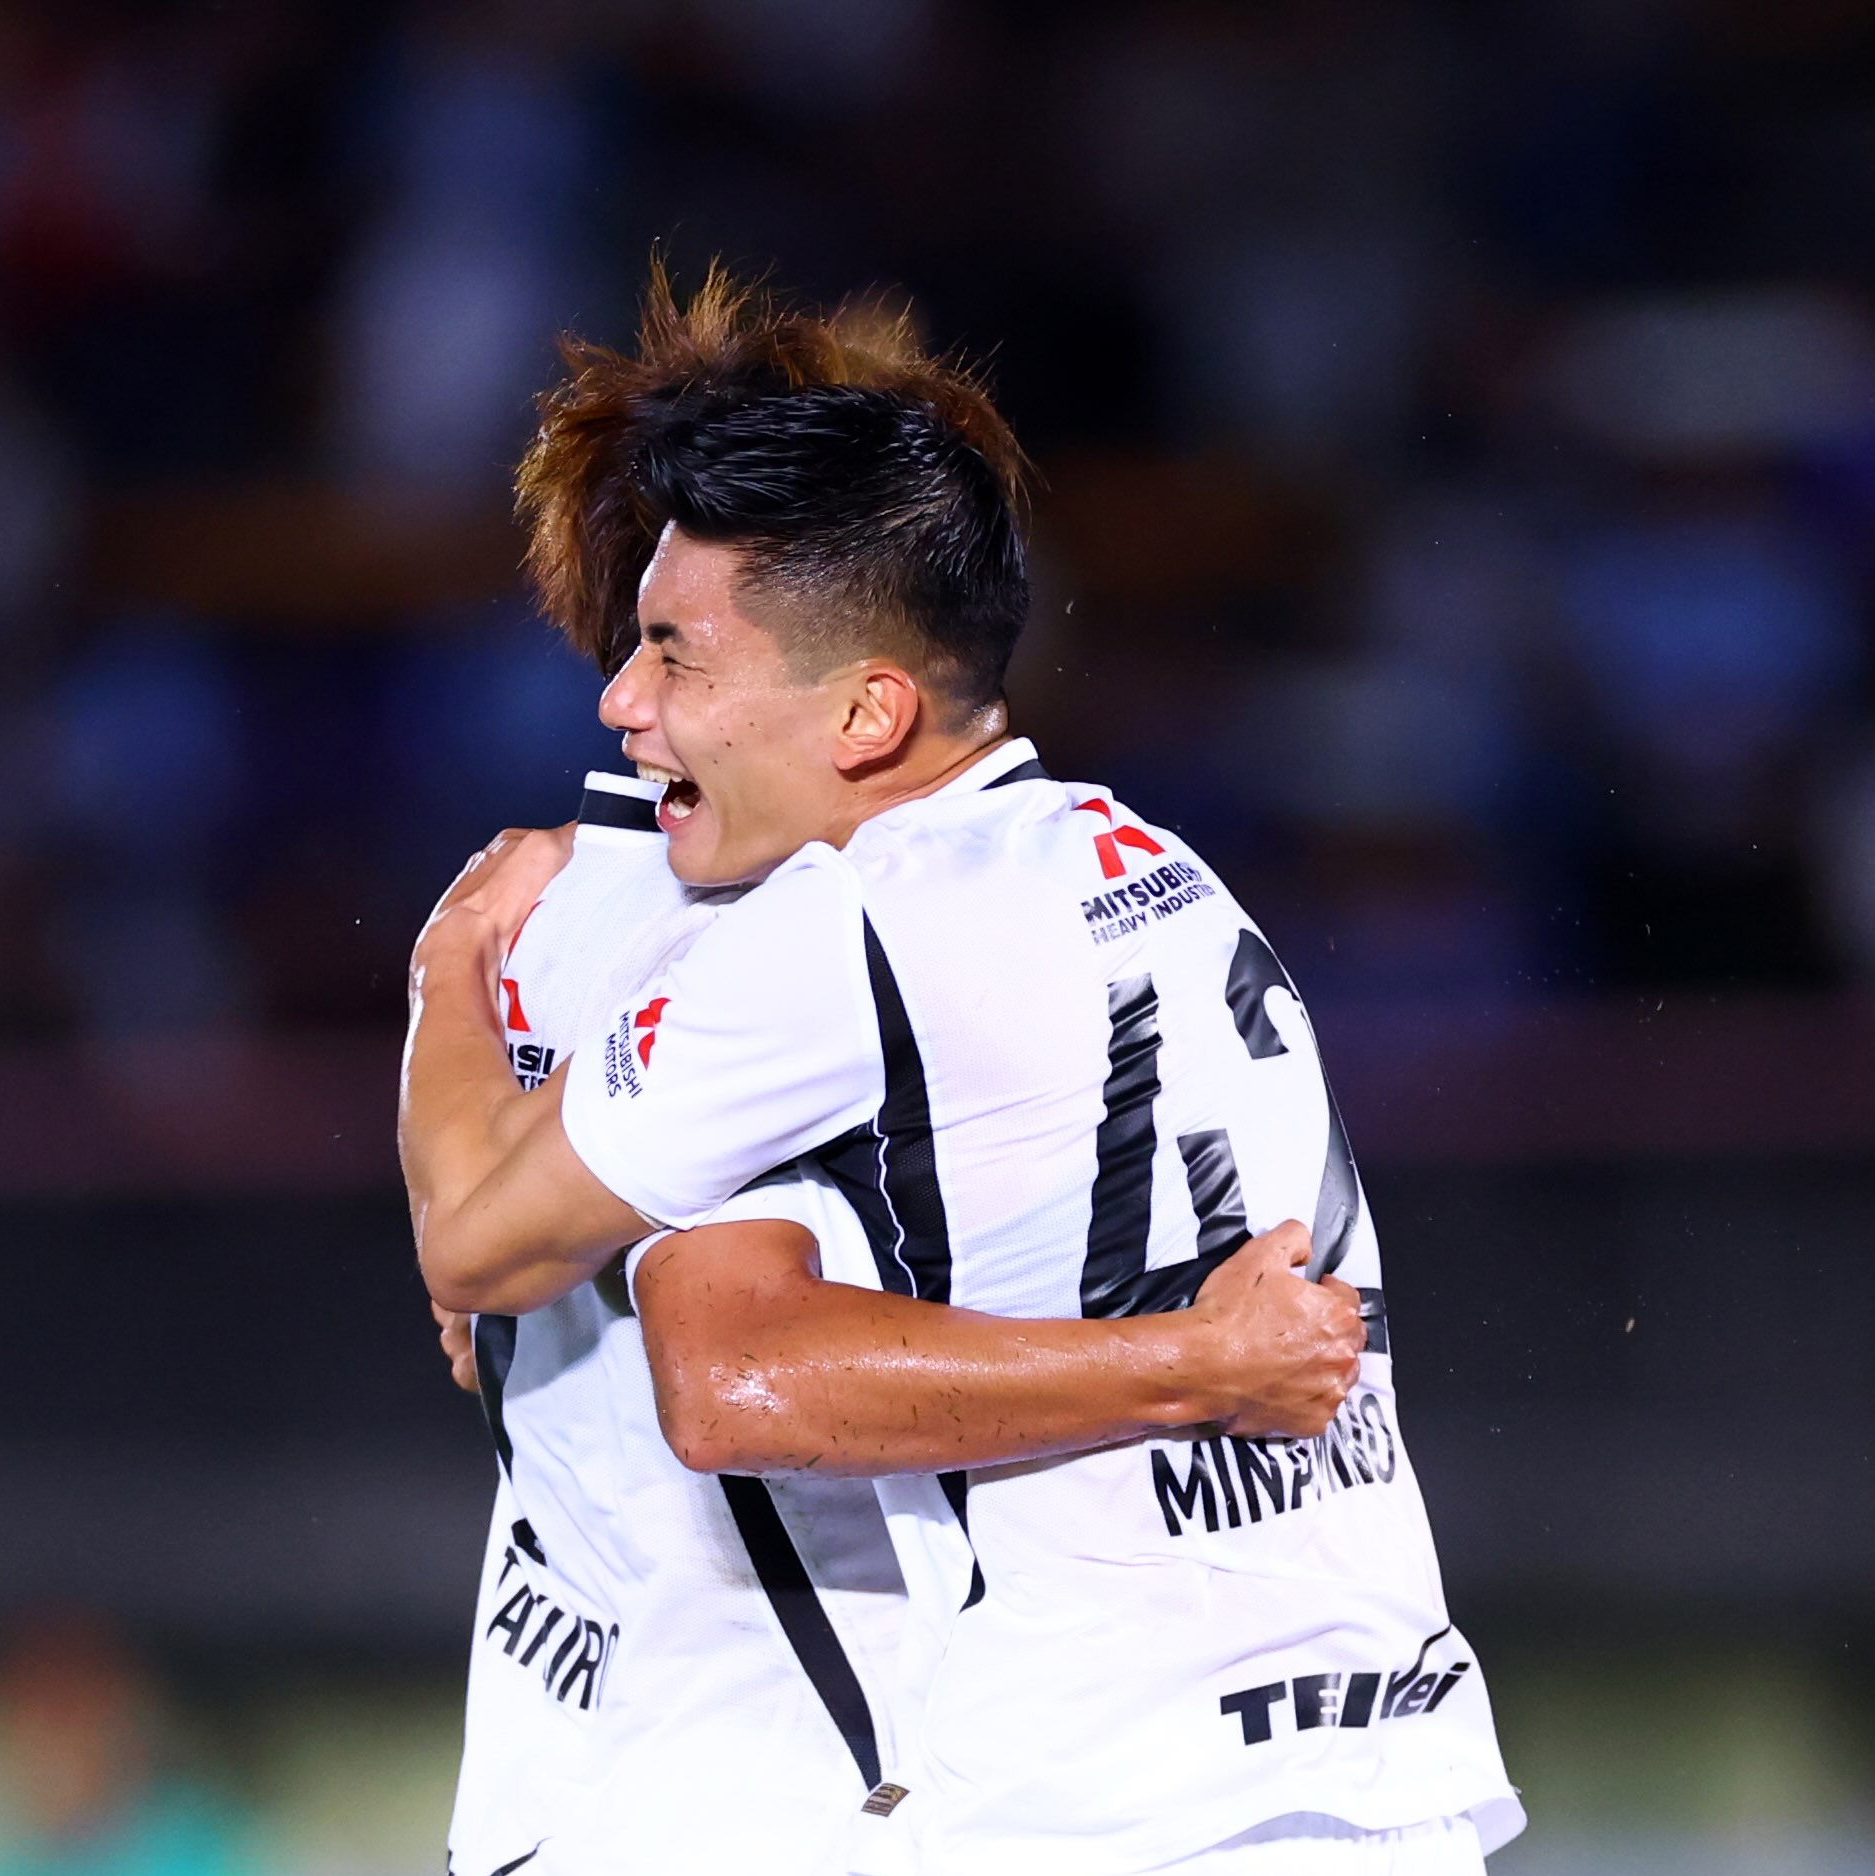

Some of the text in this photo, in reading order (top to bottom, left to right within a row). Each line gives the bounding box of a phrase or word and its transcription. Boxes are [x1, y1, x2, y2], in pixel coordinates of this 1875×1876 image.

[1090, 911, 1148, 946] HEAVY
[605, 1032, 622, 1098] MOTORS
[619, 1010, 643, 1099] MITSUBISHI
